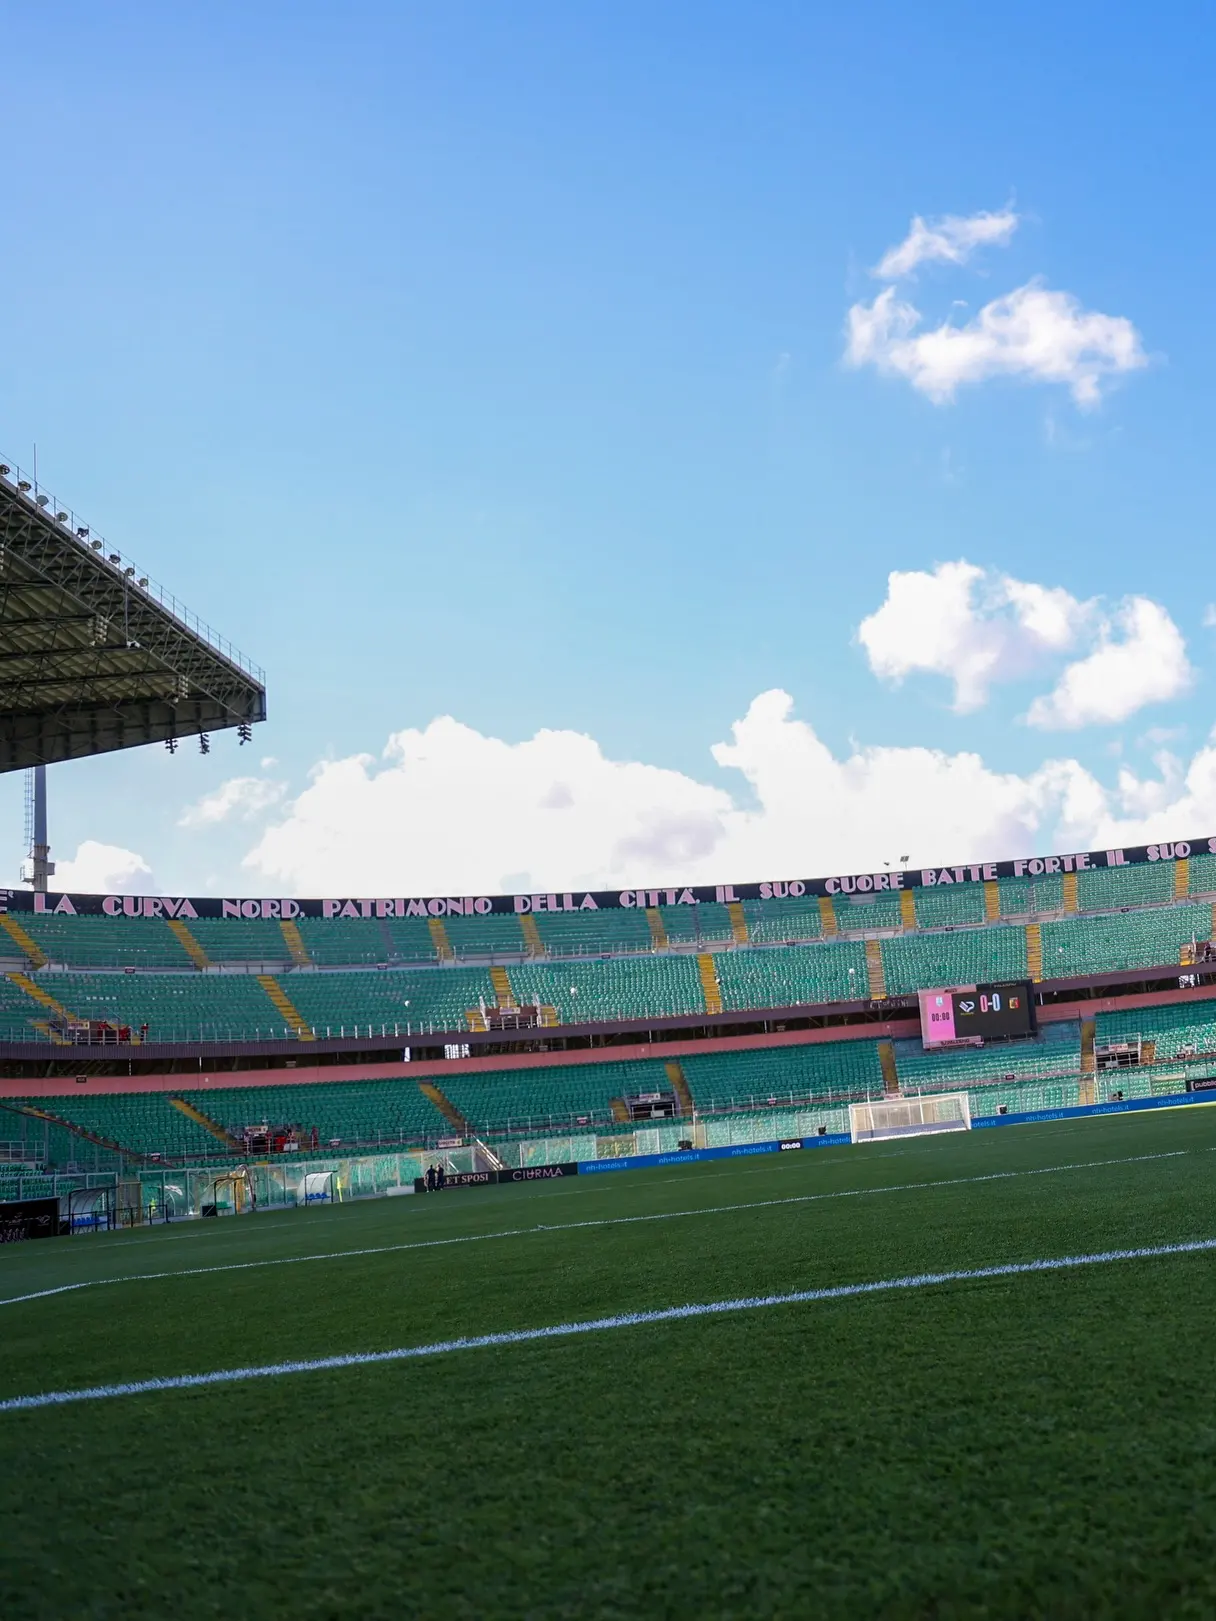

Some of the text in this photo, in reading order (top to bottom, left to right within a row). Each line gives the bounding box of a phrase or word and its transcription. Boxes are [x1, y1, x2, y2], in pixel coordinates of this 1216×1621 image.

[34, 892, 77, 915] LA
[102, 896, 199, 918] CURVA
[322, 896, 492, 918] PATRIMONIO
[514, 893, 599, 913] DELLA
[716, 885, 740, 902] IL
[759, 881, 806, 899] SUO
[825, 873, 904, 894] CUORE
[921, 863, 998, 886] BATTE
[1106, 850, 1130, 867] IL
[1146, 841, 1191, 862] SUO
[931, 1012, 950, 1022] 00:00
[781, 1142, 801, 1150] 00:00
[658, 1153, 700, 1165] nh-hotels.it
[461, 1173, 489, 1184] SPOSI
[512, 1167, 563, 1182] CIURMA
